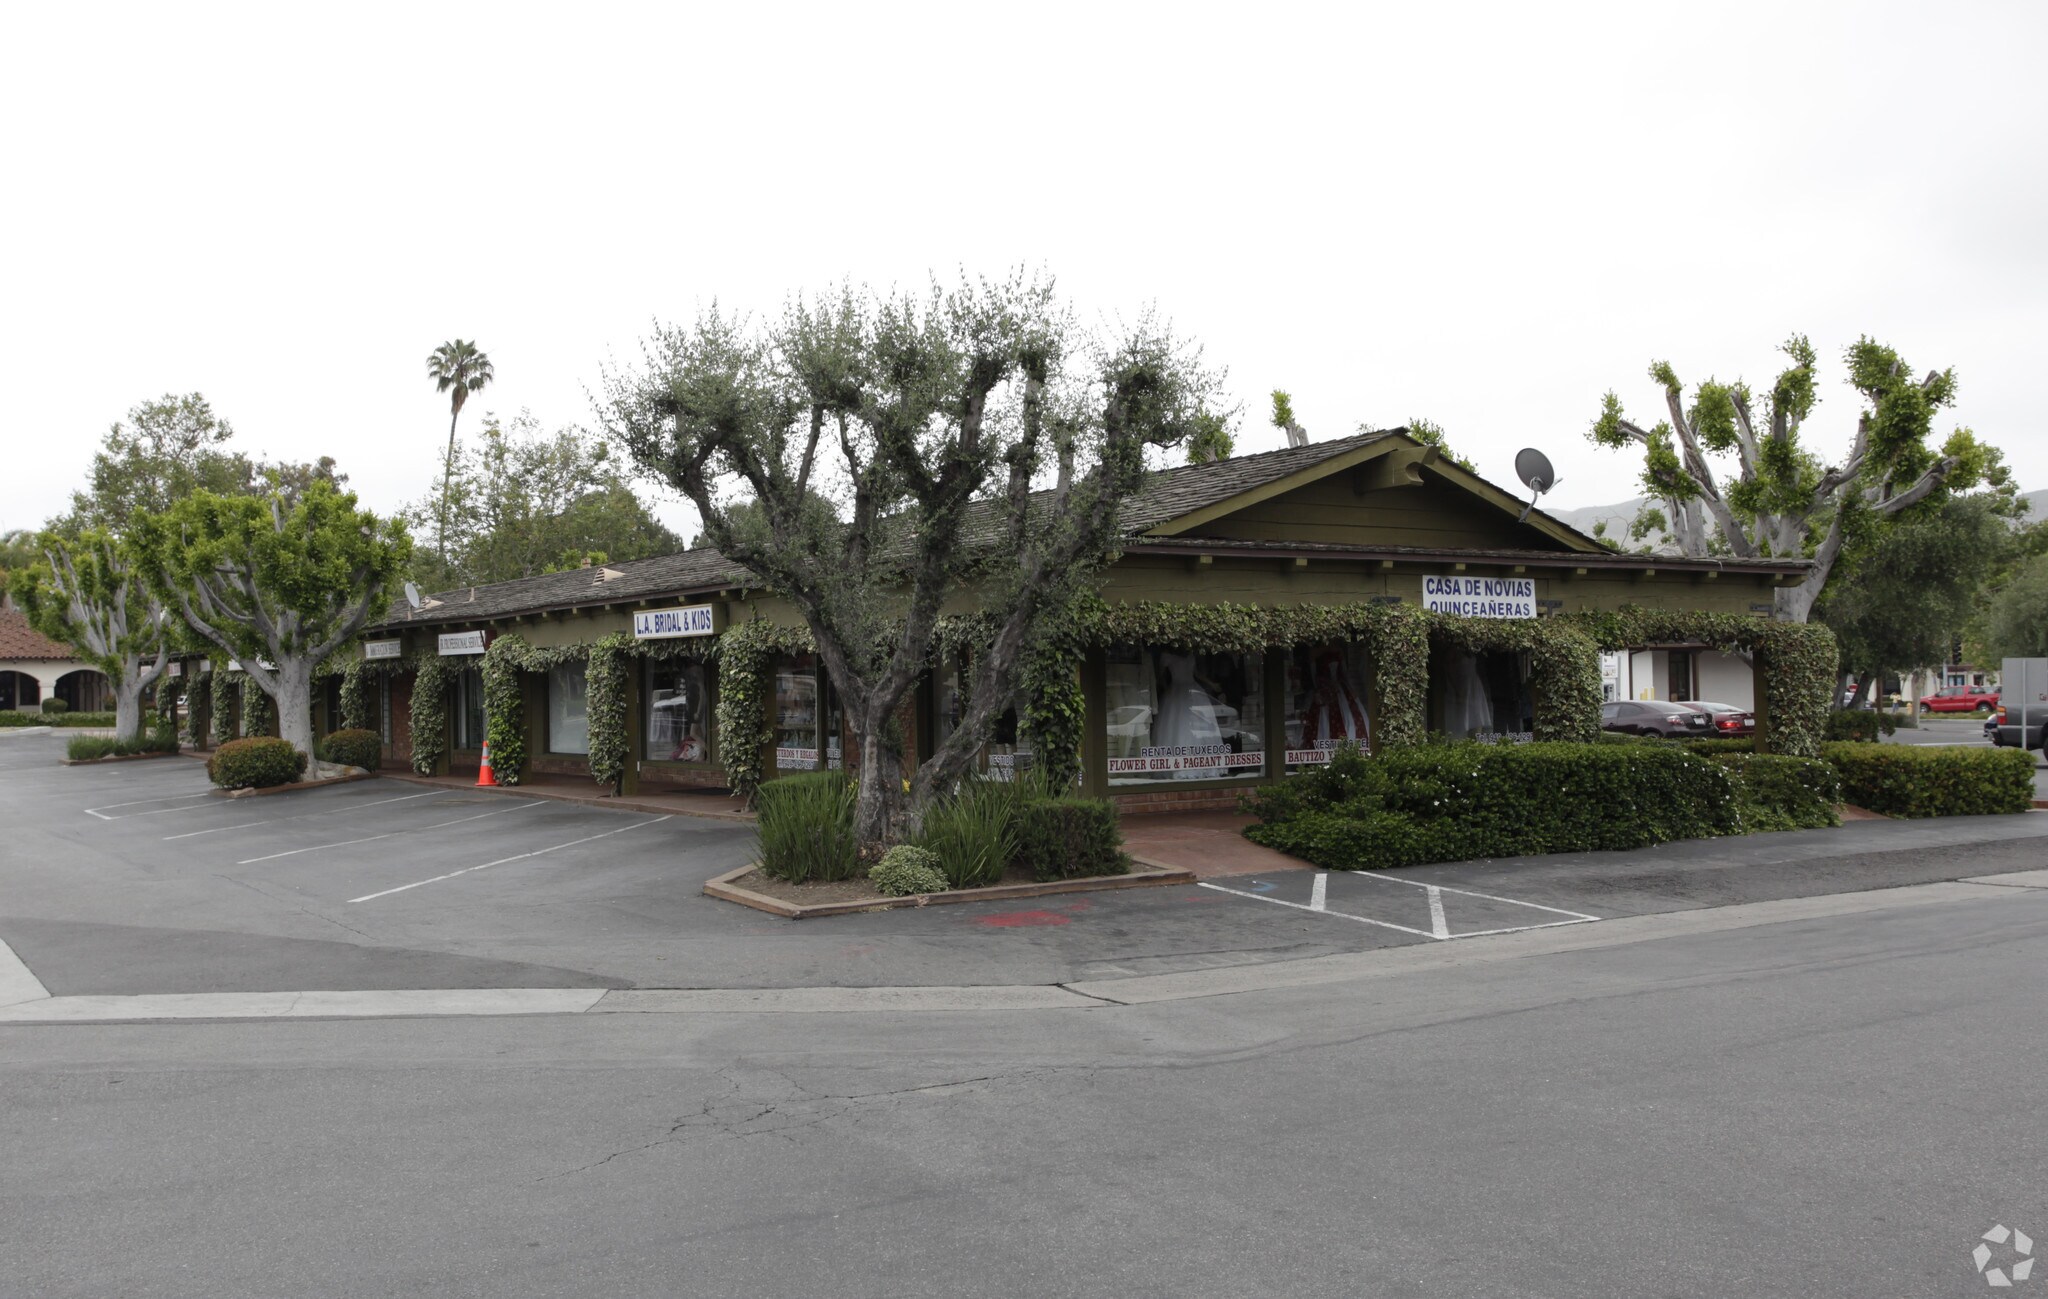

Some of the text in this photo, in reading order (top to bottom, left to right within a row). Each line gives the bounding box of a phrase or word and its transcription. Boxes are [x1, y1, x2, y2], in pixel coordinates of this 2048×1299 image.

[1426, 578, 1532, 597] CASA DE NOVIAS
[1430, 600, 1530, 616] QUINCEAÑERAS
[636, 609, 711, 635] L.A. BRIDAL & KIDS
[1141, 744, 1232, 758] RENTA DE TUXEDOS
[1288, 751, 1325, 762] BAUTIZO
[1109, 753, 1262, 771] FLOWER GIRL & PAGEANT DRESSES
